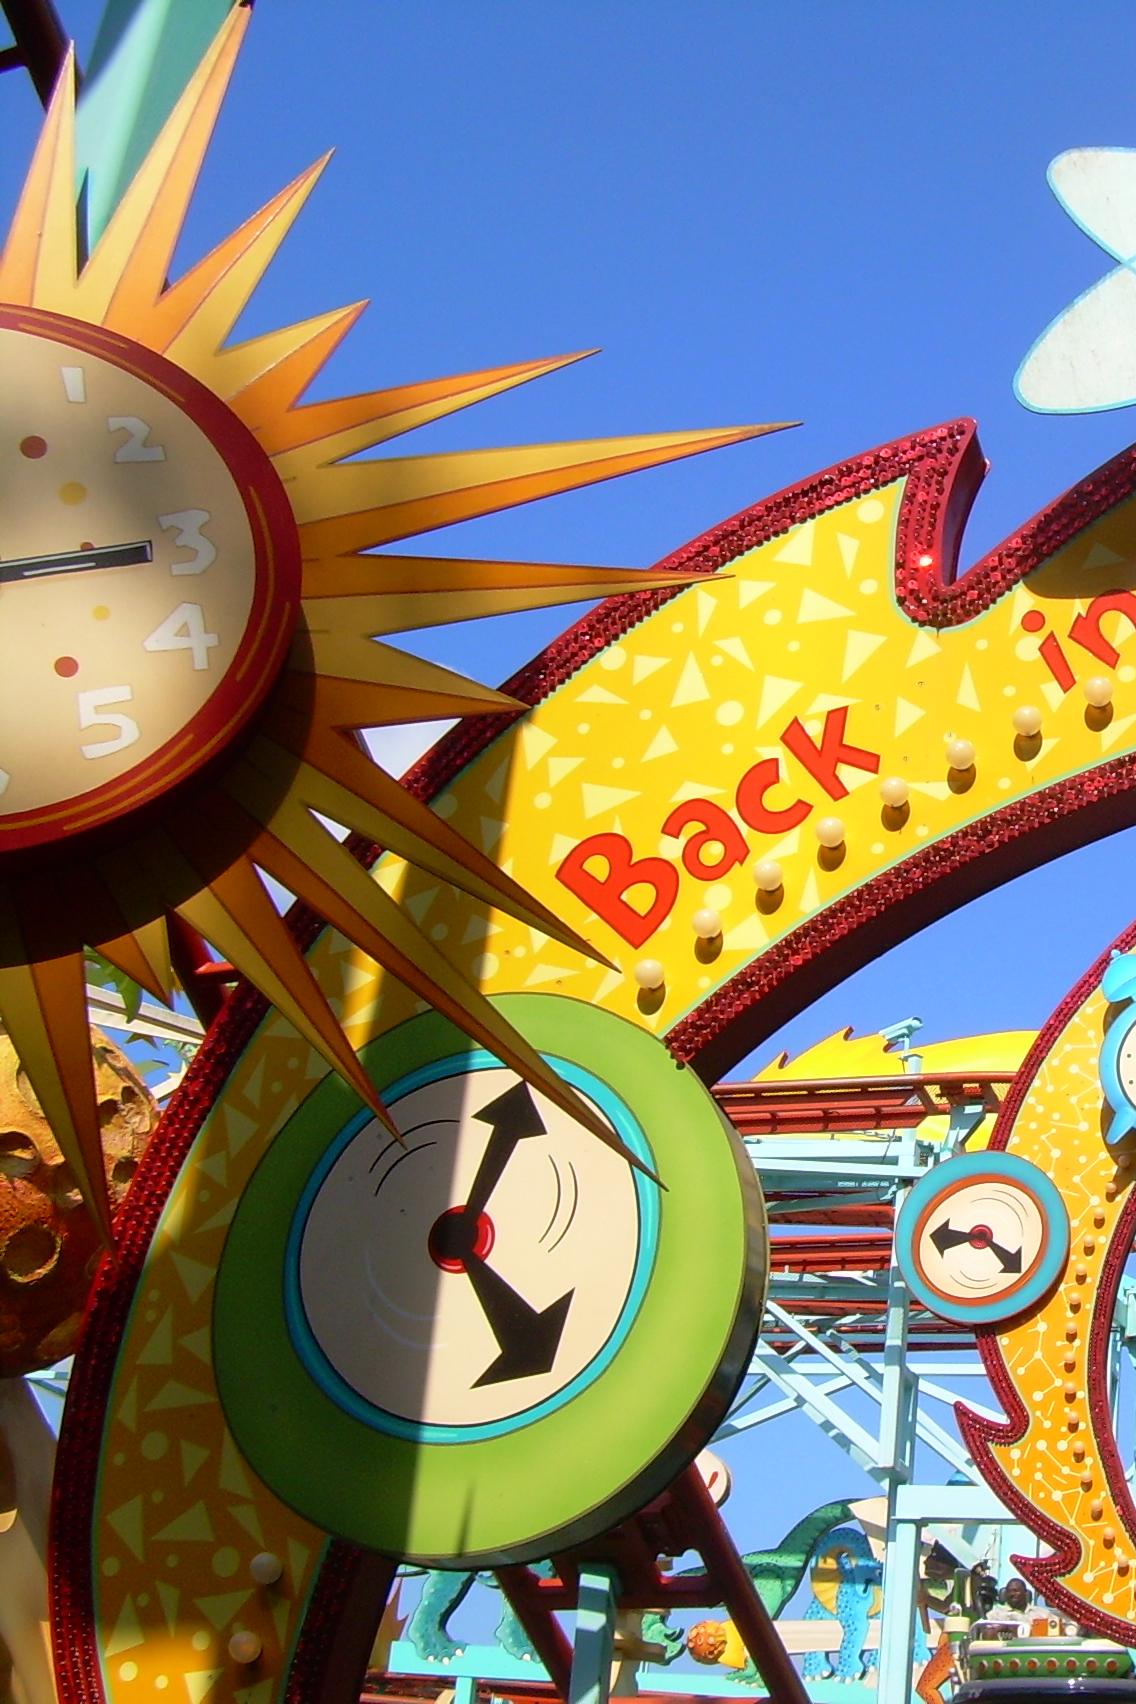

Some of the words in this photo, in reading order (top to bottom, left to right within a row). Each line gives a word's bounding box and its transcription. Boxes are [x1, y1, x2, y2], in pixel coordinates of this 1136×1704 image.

[60, 366, 87, 404] 1
[107, 416, 167, 464] 2
[156, 508, 218, 577] 3
[143, 601, 219, 671] 4
[76, 685, 141, 761] 5
[555, 704, 881, 950] Back
